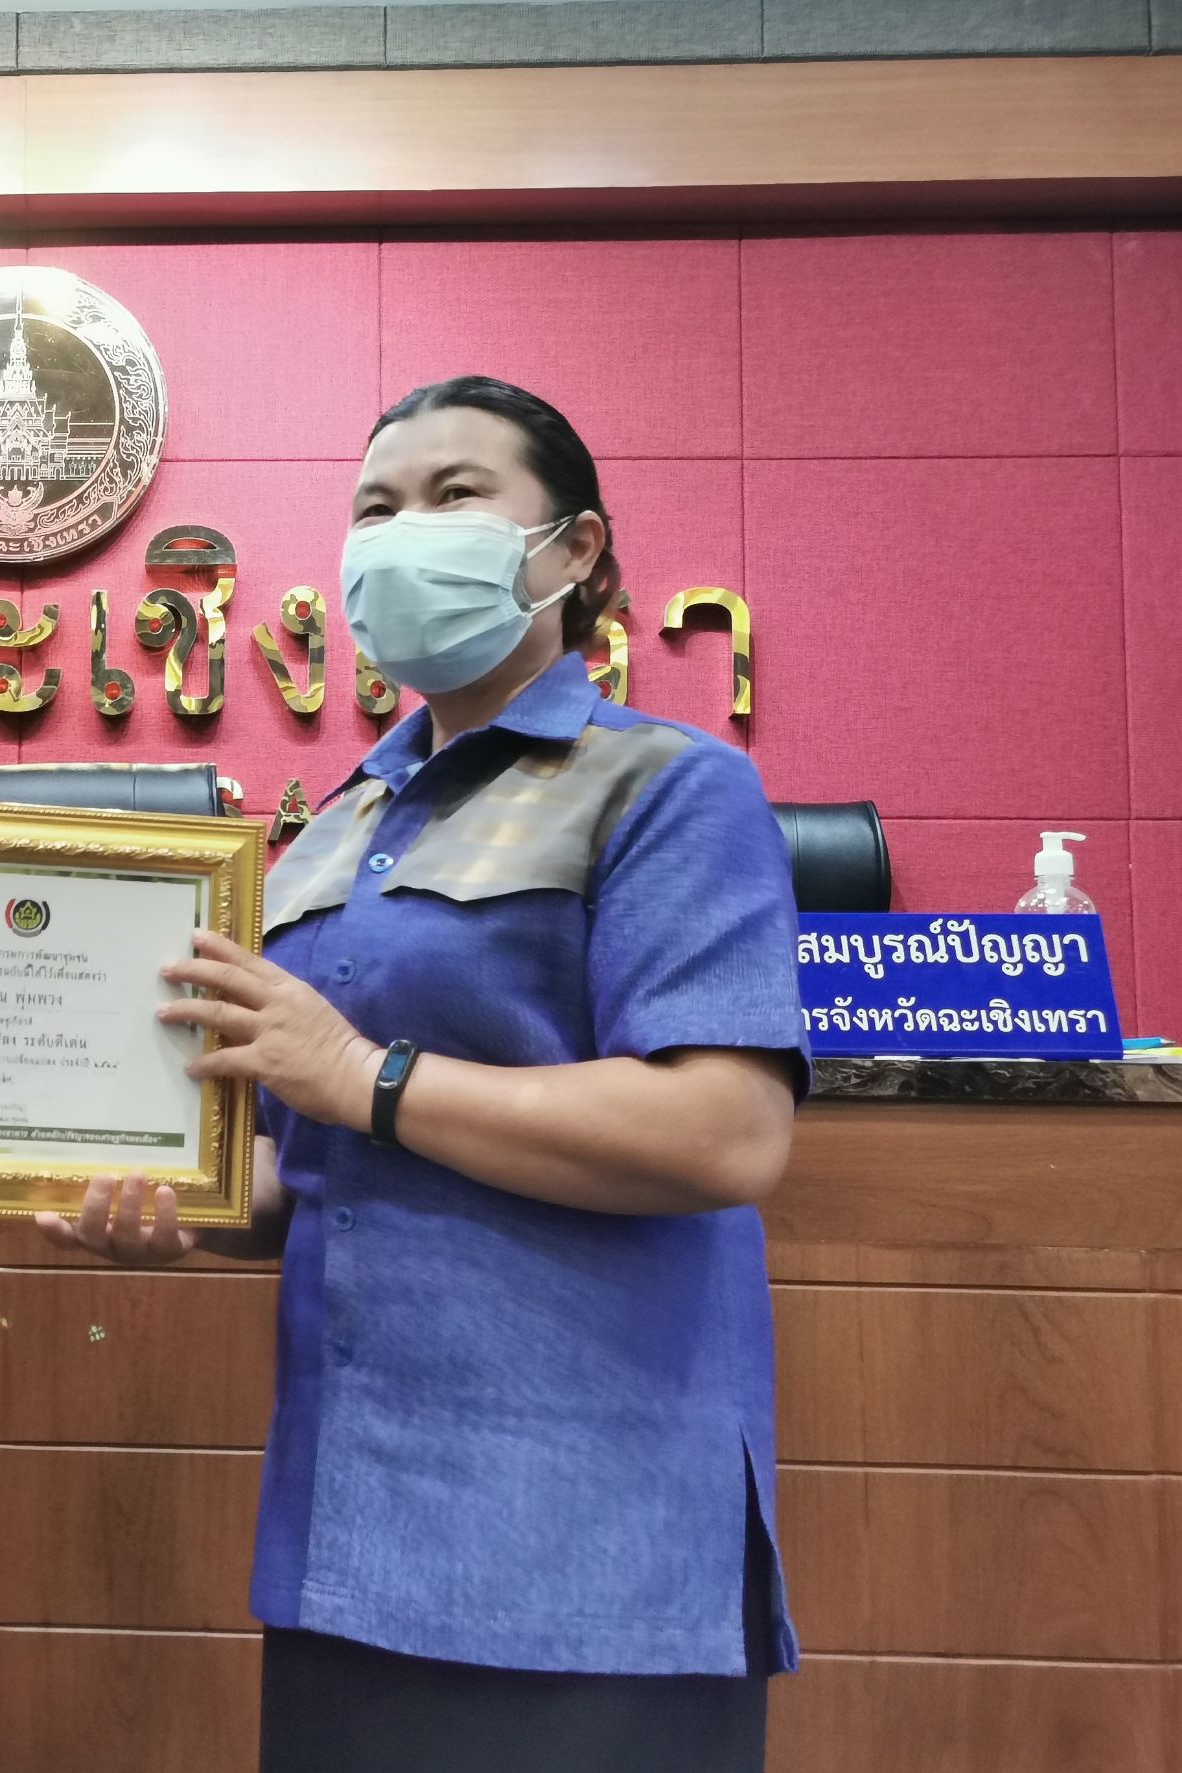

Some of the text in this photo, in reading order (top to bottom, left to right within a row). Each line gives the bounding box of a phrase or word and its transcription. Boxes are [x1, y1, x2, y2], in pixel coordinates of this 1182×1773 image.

[797, 918, 1089, 979] สมบูรณ์ปัญญา
